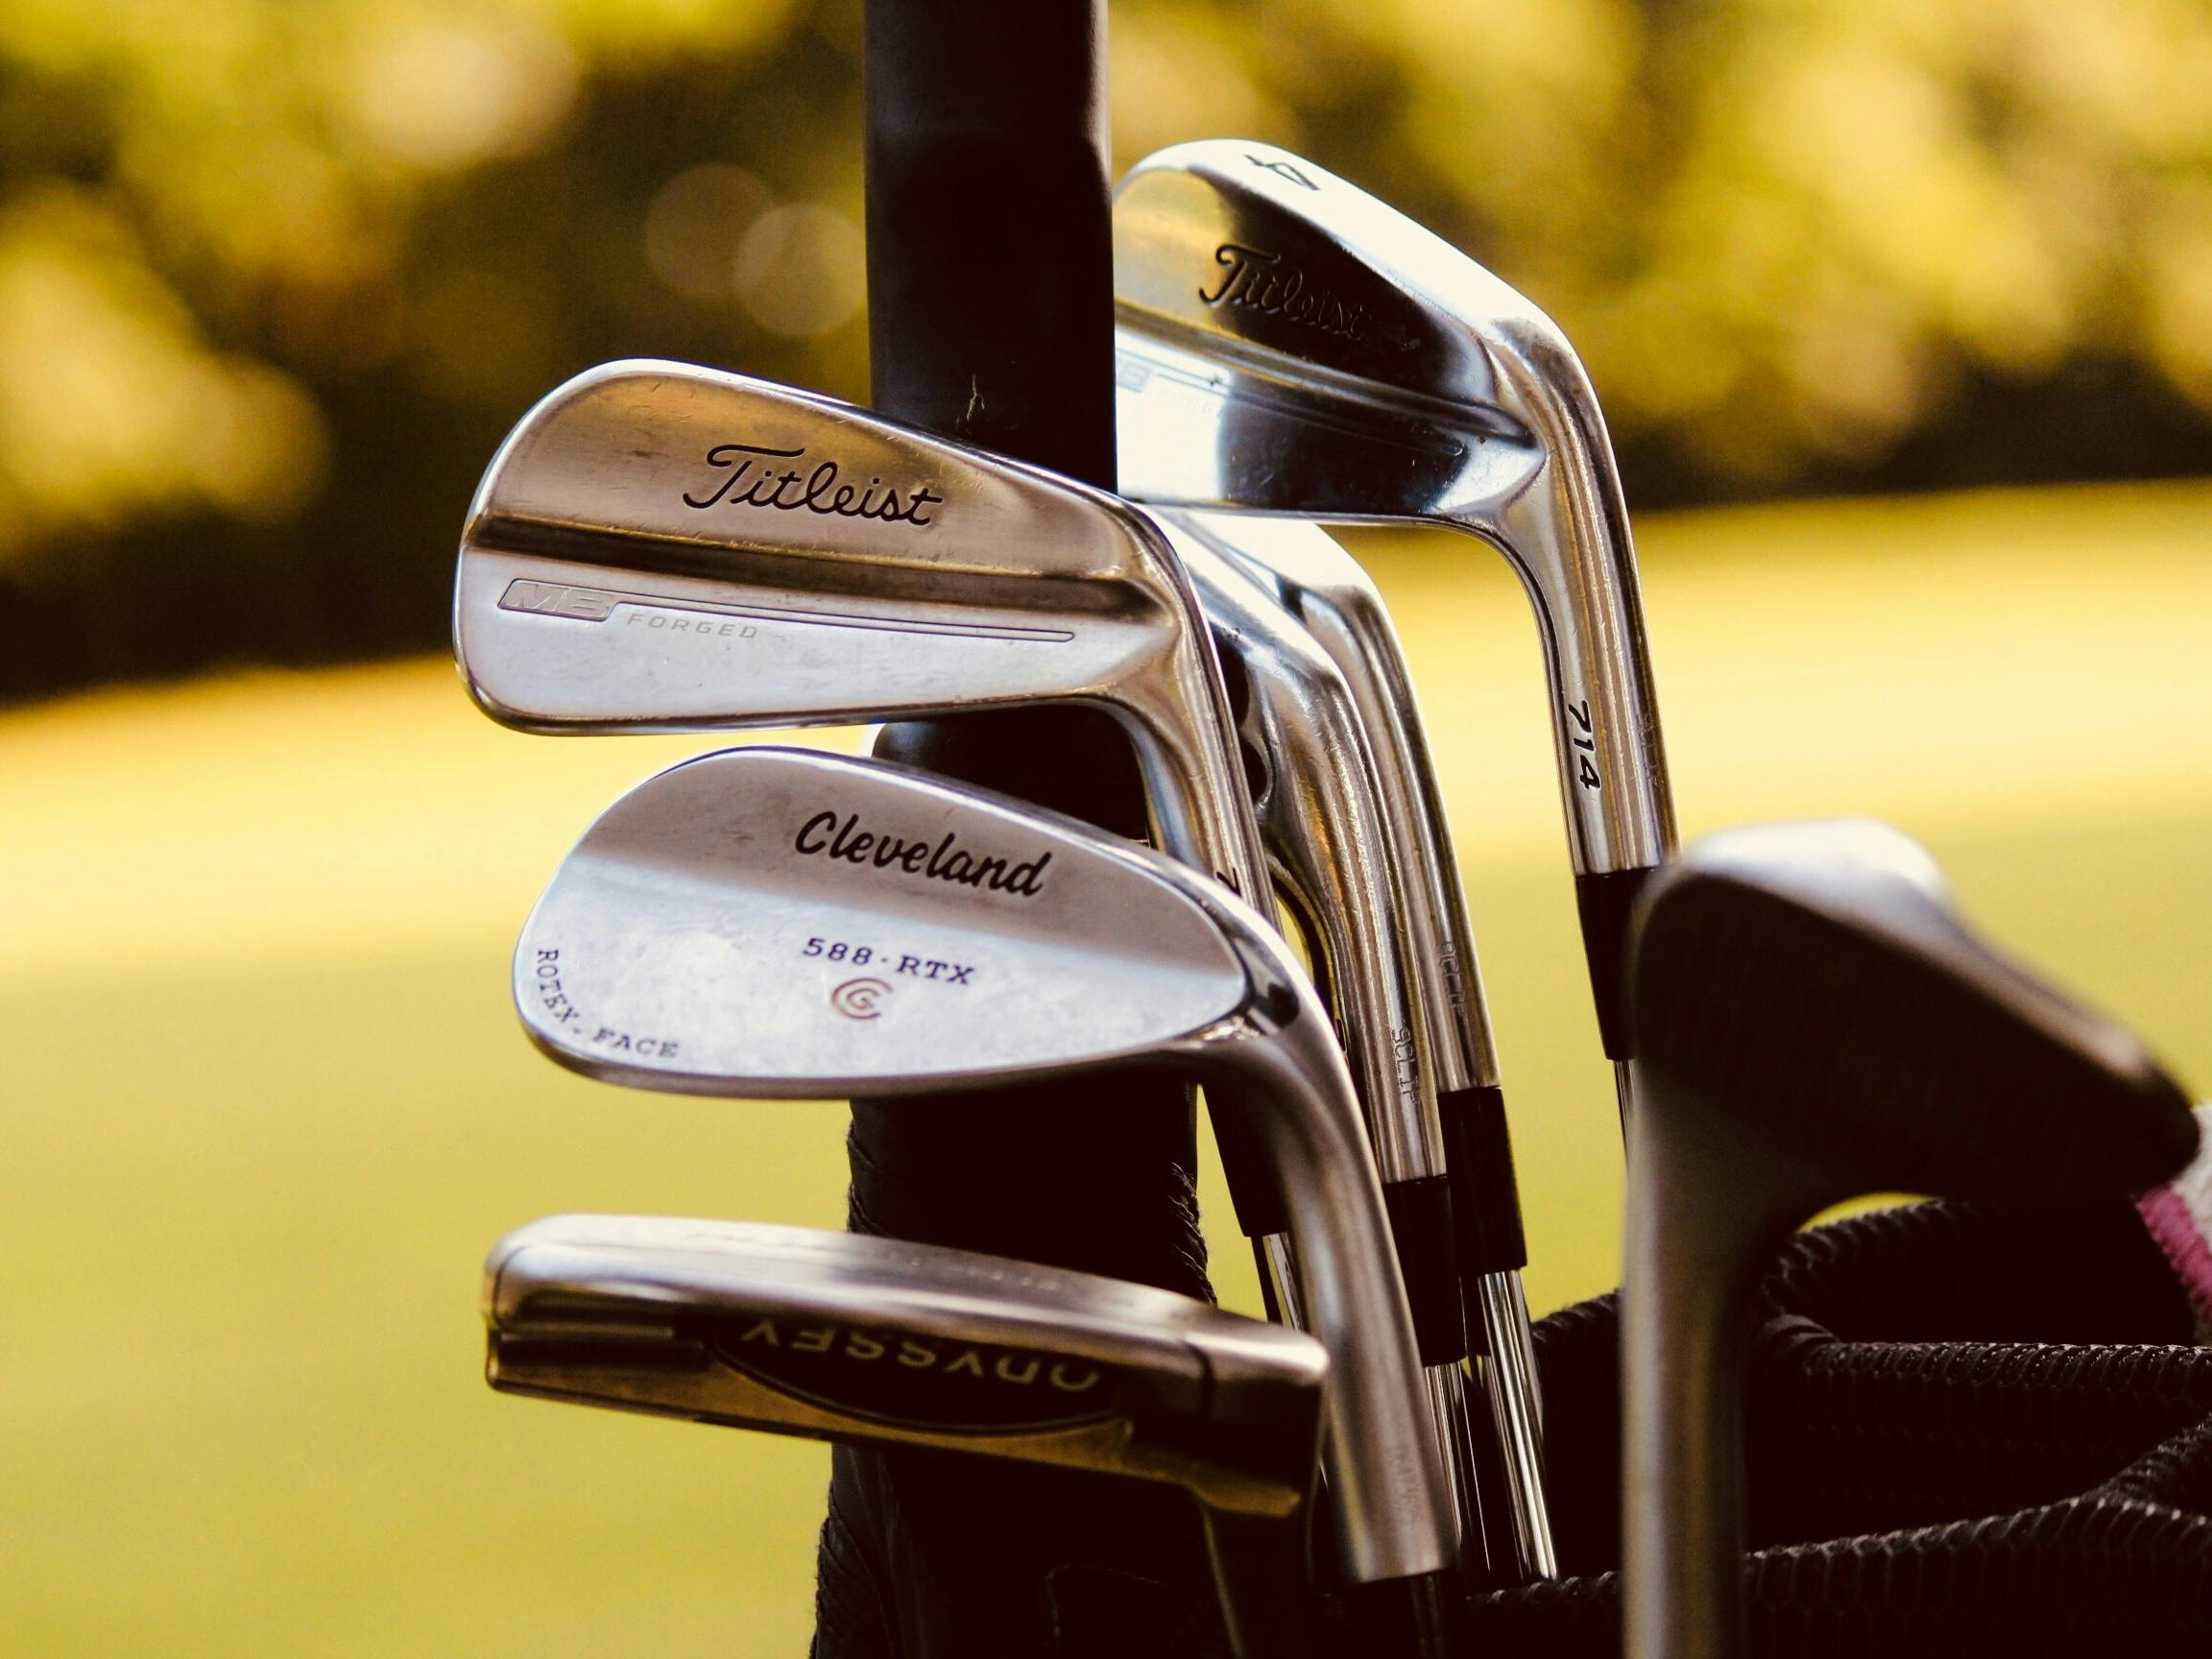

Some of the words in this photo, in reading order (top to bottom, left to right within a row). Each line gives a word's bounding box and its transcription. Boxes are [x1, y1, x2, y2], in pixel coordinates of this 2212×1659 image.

[683, 444, 944, 527] Titleist
[625, 613, 759, 639] FORGED
[1567, 699, 1602, 791] 714
[794, 810, 1053, 897] Cleveland
